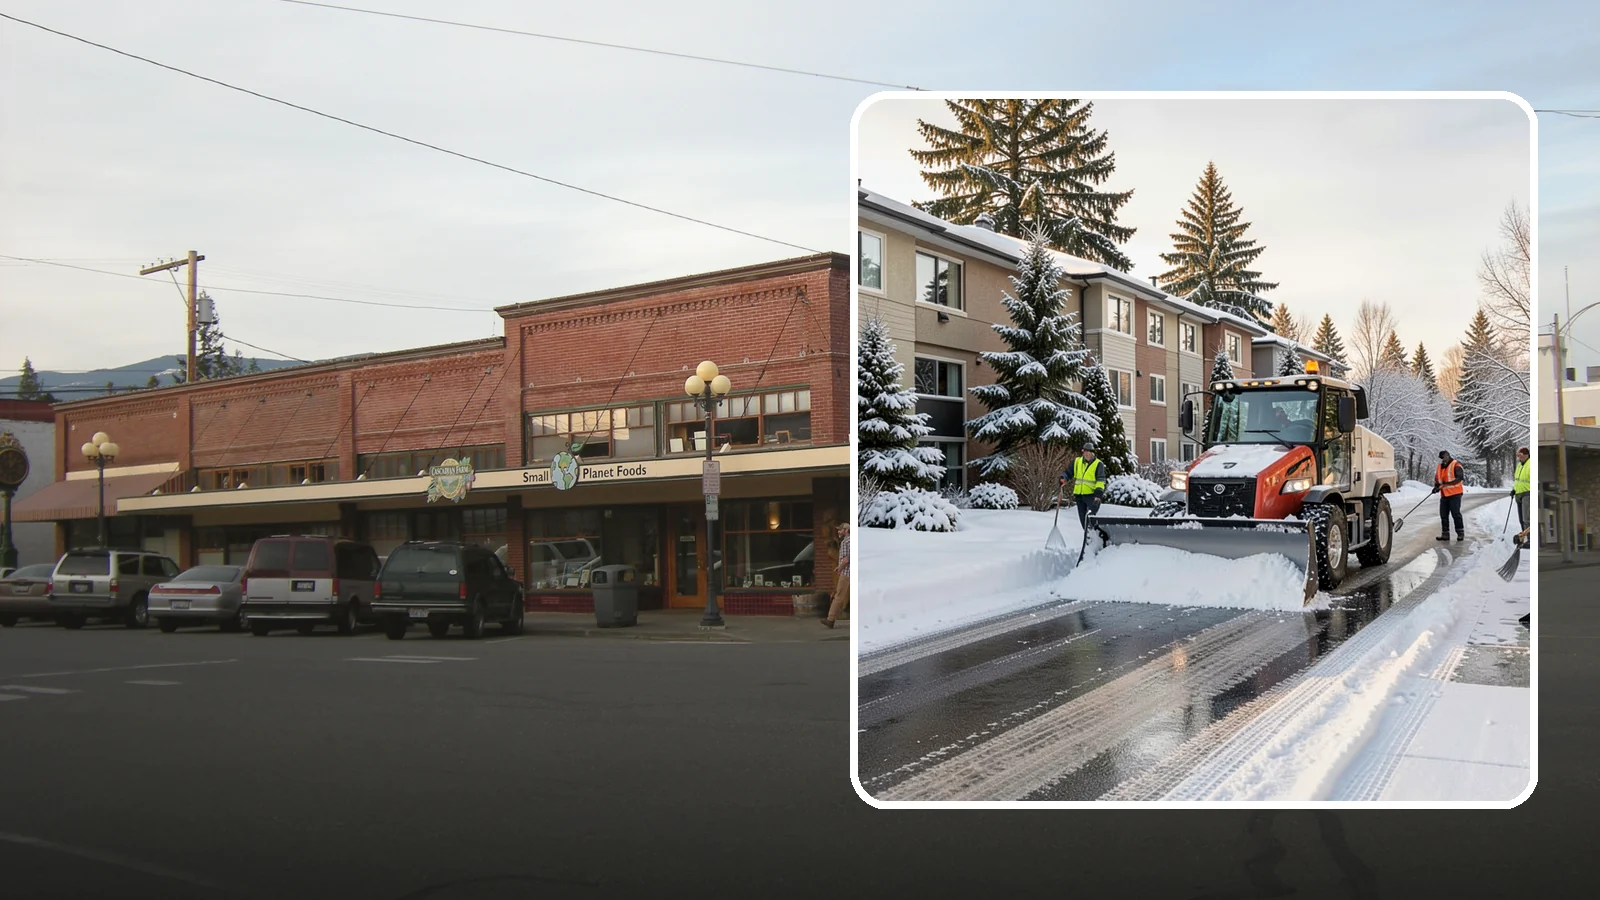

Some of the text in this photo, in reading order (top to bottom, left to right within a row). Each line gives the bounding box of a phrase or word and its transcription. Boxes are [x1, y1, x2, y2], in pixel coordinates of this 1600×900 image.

[523, 464, 647, 482] Small Planet Foods
